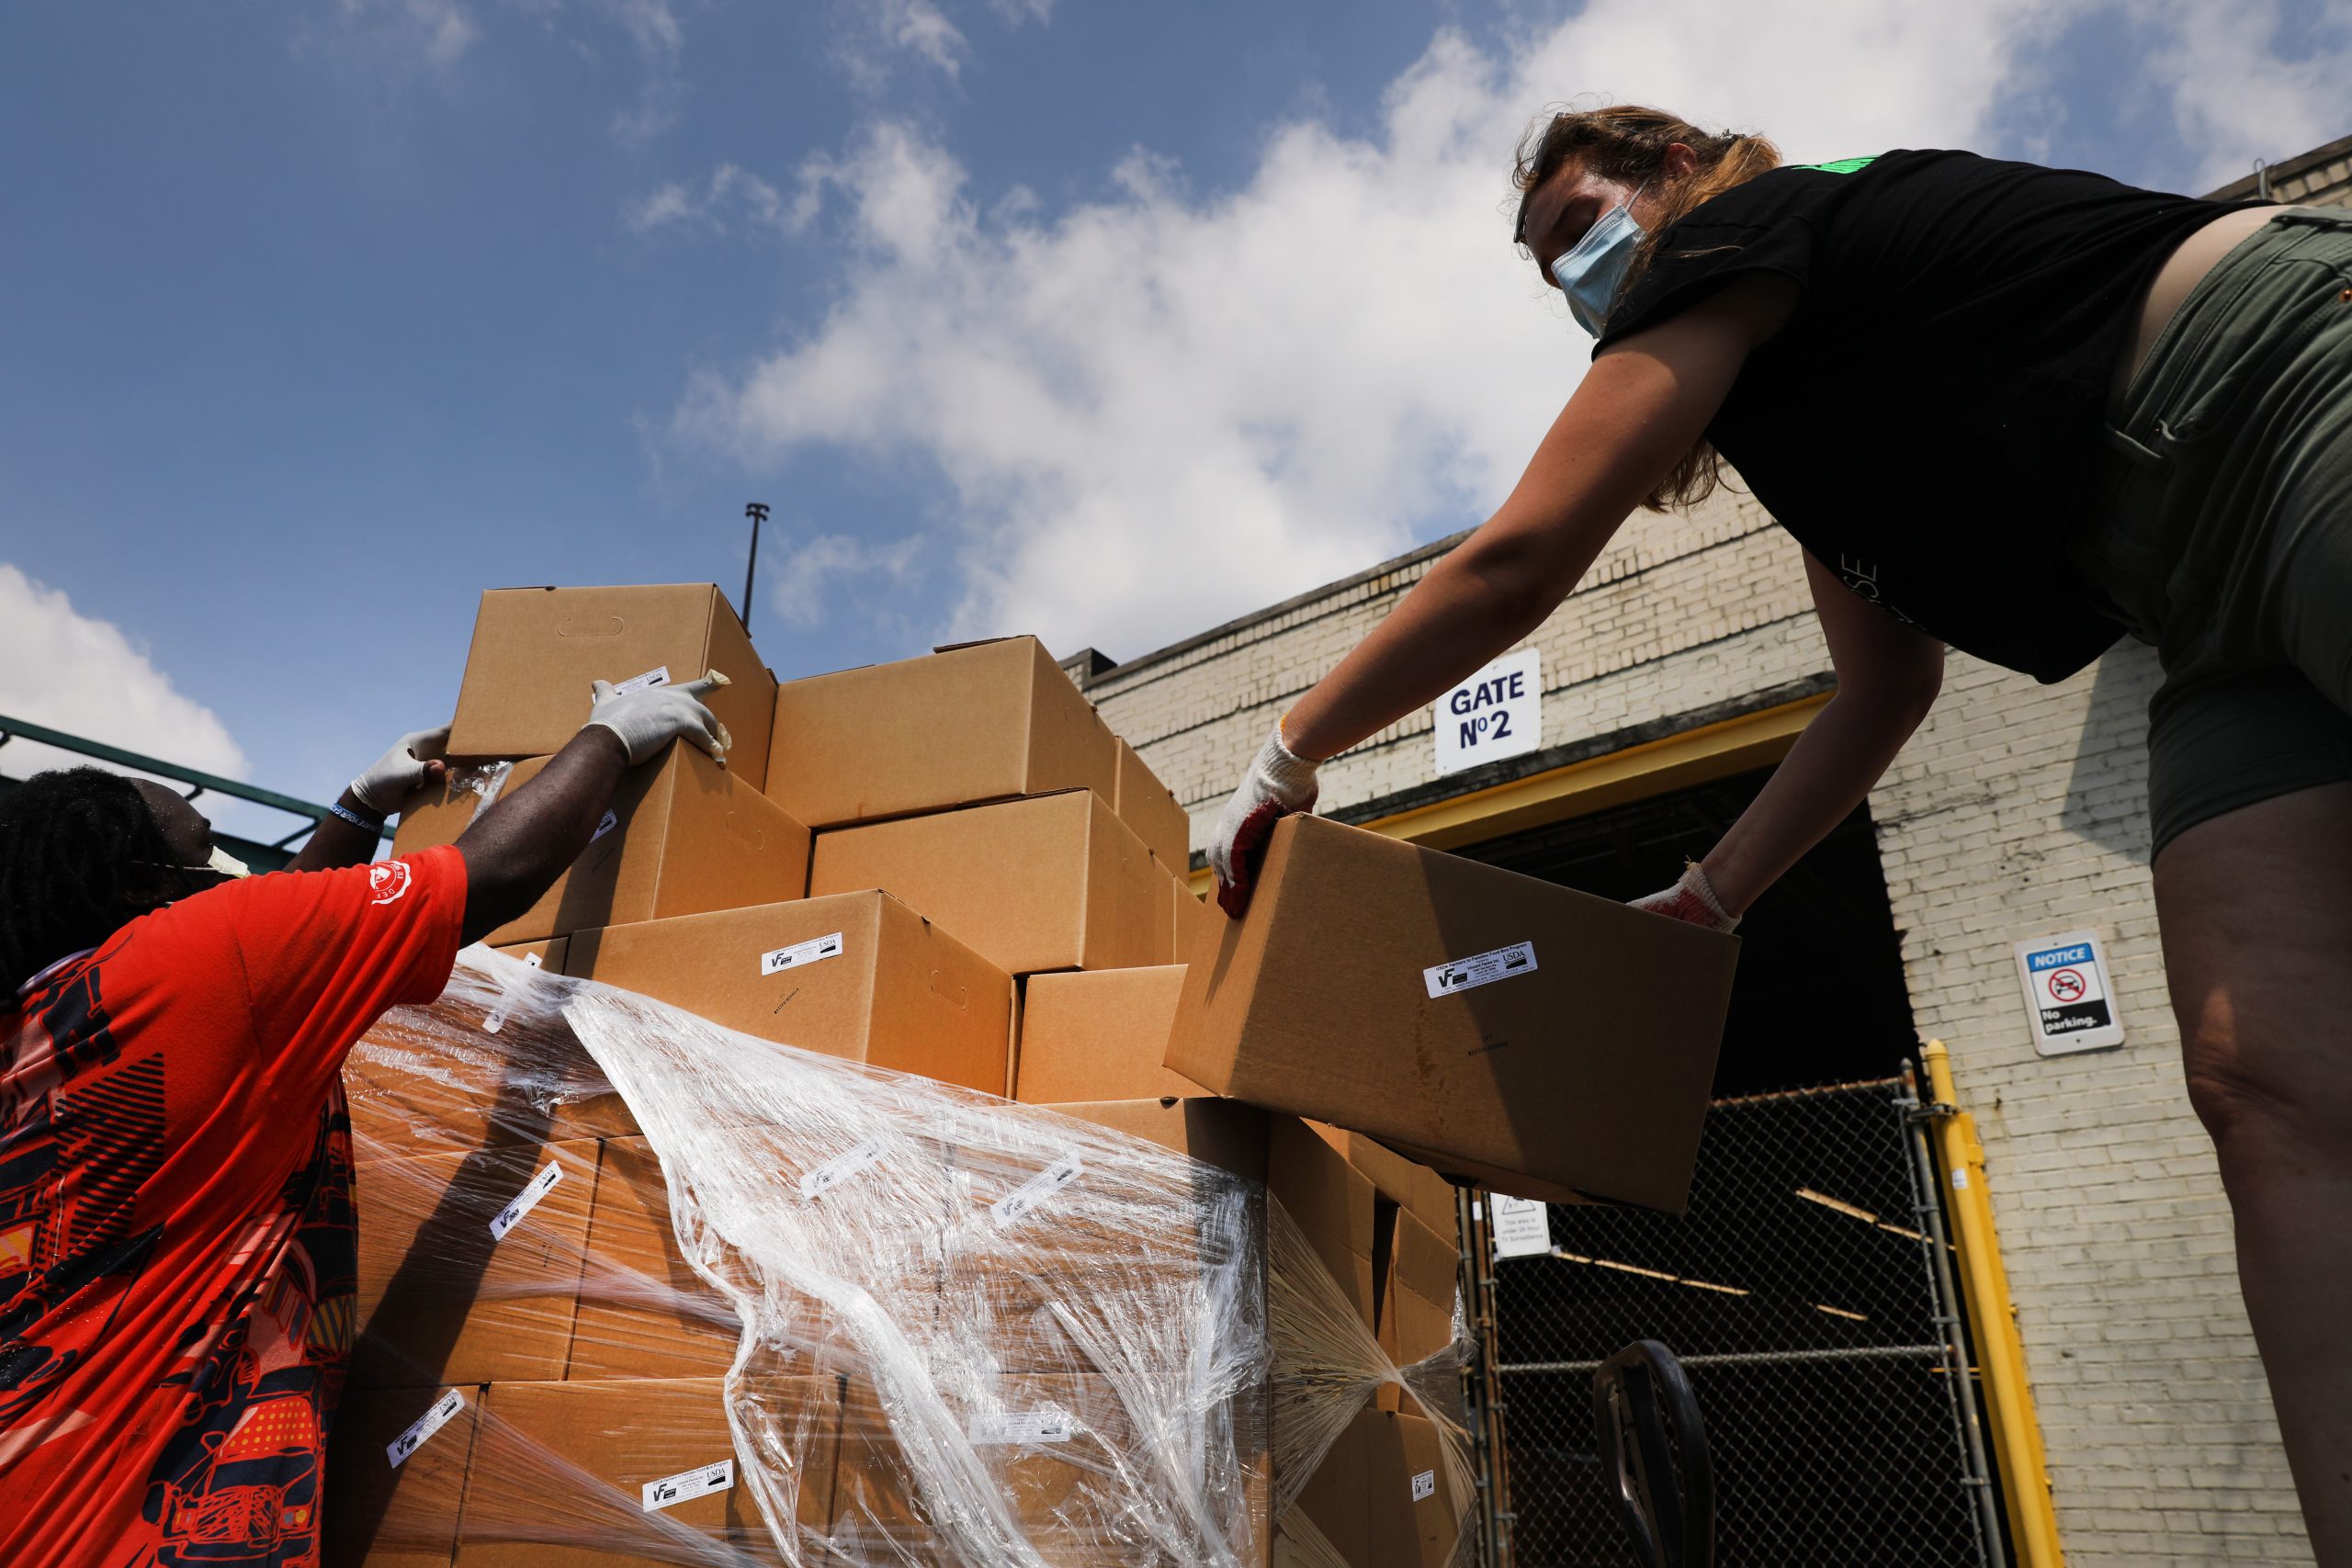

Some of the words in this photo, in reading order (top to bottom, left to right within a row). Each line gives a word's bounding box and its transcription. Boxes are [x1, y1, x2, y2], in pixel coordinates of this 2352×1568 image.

[1451, 671, 1524, 715] GATE
[1503, 950, 1525, 962] USDA
[2034, 948, 2085, 967] NOTICE
[2041, 1010, 2061, 1021] No
[707, 1467, 725, 1479] USDA
